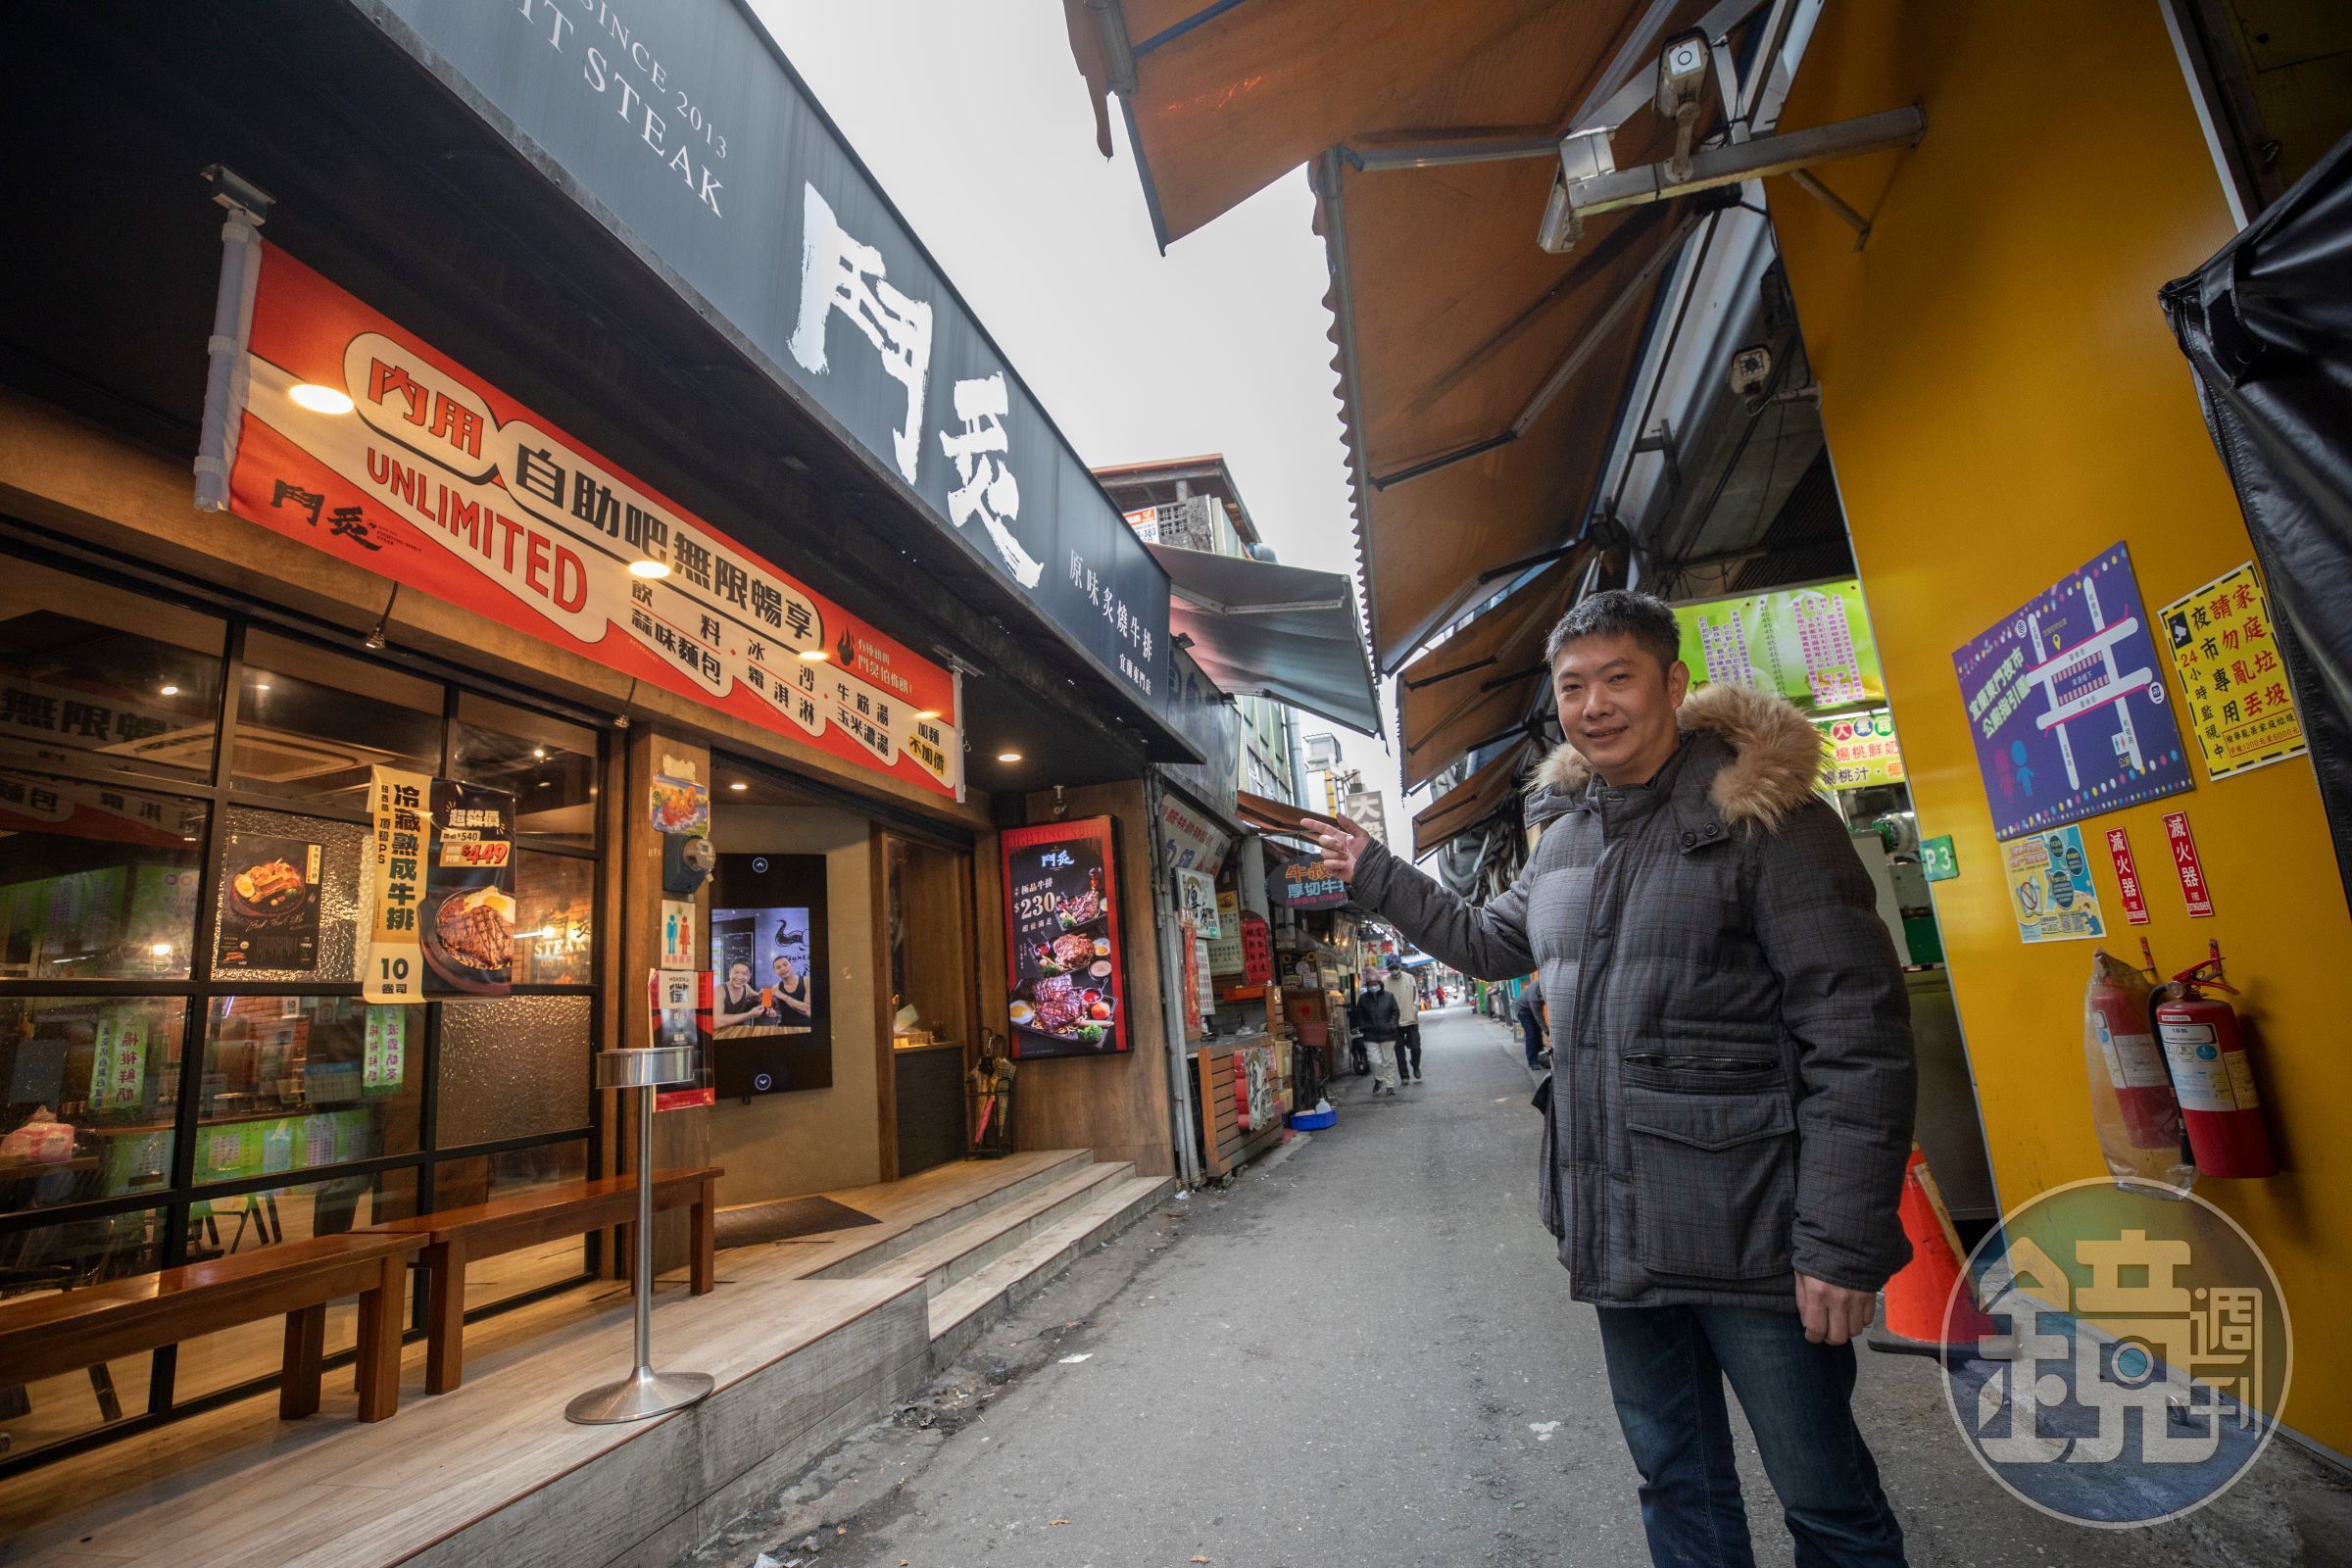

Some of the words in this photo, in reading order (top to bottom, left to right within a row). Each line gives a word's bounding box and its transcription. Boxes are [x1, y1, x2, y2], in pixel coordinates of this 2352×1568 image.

[584, 47, 723, 219] STEAK
[677, 91, 726, 158] 2013
[368, 357, 484, 460] 內用
[367, 447, 587, 613] UNLIMITED
[515, 442, 812, 640] 自助吧無限暢享
[632, 579, 720, 647] 飲料
[1069, 549, 1152, 662] 原味炙燒牛排
[631, 608, 720, 686] 蒜味麵包
[747, 638, 814, 692] 冰沙
[1119, 653, 1152, 696] 宜蘭東門店
[2191, 607, 2240, 725] 夜市專用
[2209, 594, 2263, 717] 請勿亂丟
[2232, 583, 2289, 707] 家庭垃圾
[748, 665, 815, 726] 霜淇淋
[837, 683, 889, 726] 牛筋湯
[2180, 650, 2224, 760] 24小時監視中
[837, 707, 889, 757] 玉米濃湯
[909, 735, 945, 774] 不加價
[377, 818, 391, 864] 頂級PS
[385, 784, 421, 931] 冷藏熟成牛排
[461, 843, 508, 864] $449
[2109, 832, 2136, 897] 滅火器
[2169, 816, 2199, 888] 滅火器
[1014, 892, 1055, 920] $230
[381, 957, 409, 980] 10
[381, 983, 408, 995] 盎司
